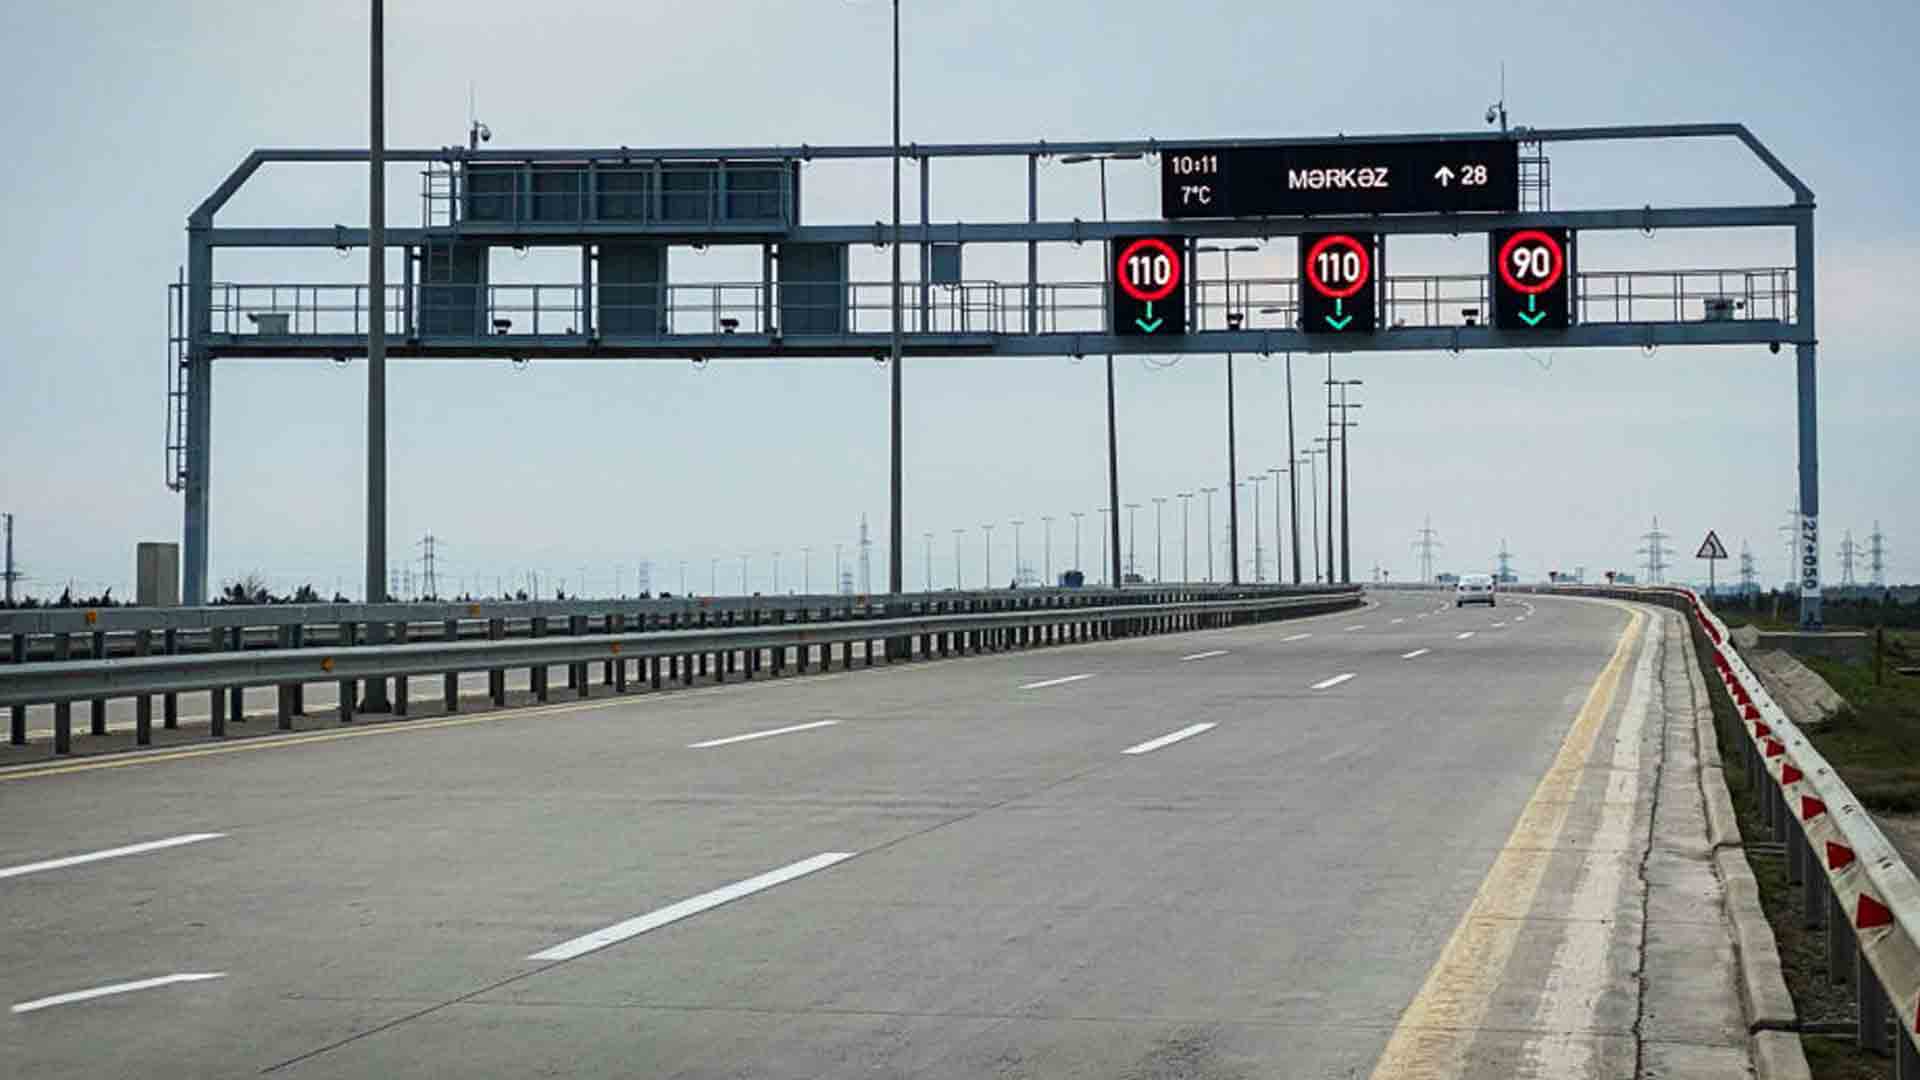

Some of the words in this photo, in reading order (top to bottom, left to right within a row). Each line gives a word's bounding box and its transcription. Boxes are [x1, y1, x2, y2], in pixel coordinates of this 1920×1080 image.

[1172, 155, 1217, 175] 10:11
[1461, 164, 1488, 185] 28
[1288, 167, 1389, 189] MƏRKƏZ
[1181, 185, 1212, 204] 7°C
[1128, 254, 1171, 286] 110
[1318, 250, 1361, 282] 110
[1512, 246, 1550, 278] 90
